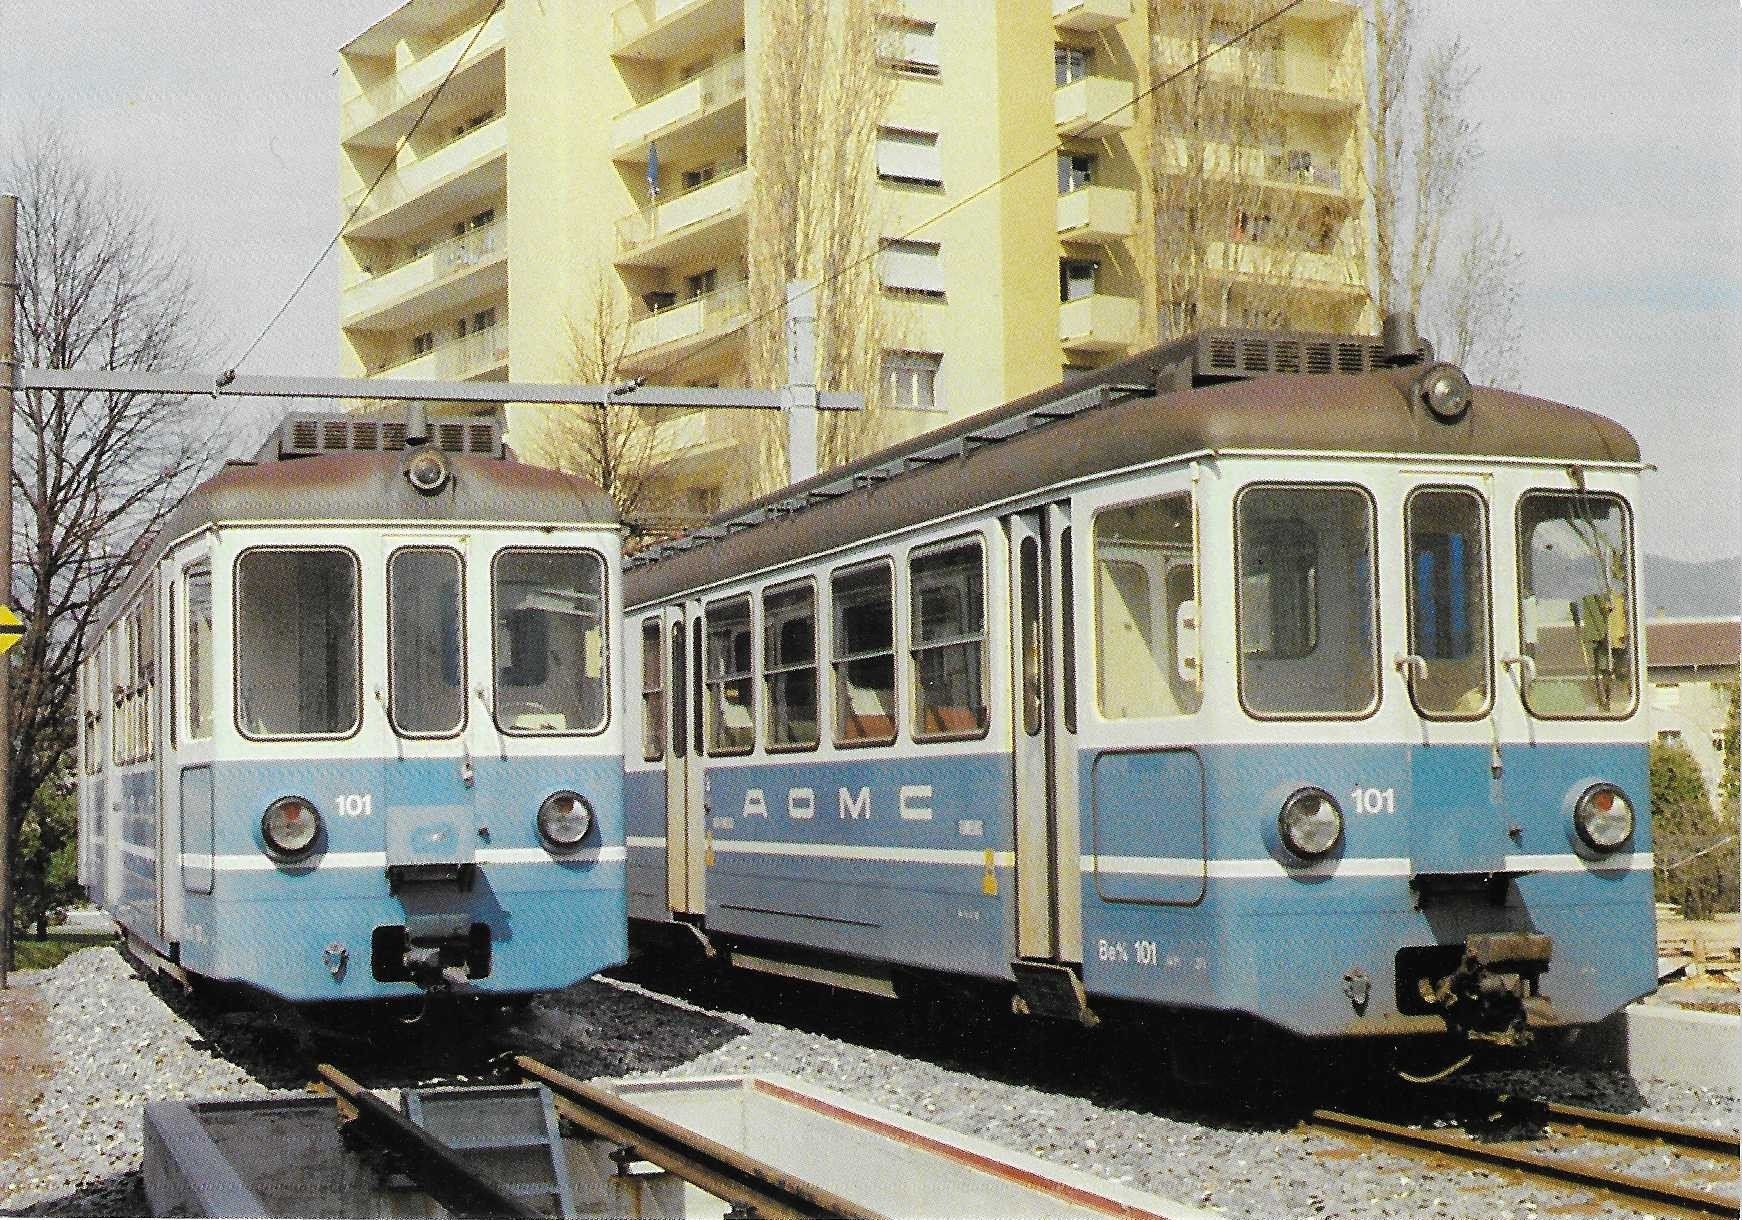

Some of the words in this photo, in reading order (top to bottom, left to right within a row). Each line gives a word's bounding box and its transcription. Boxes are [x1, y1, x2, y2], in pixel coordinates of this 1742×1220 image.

[335, 793, 372, 816] 101
[743, 784, 933, 820] AOMC
[1350, 788, 1394, 815] 101
[1134, 940, 1157, 966] 101
